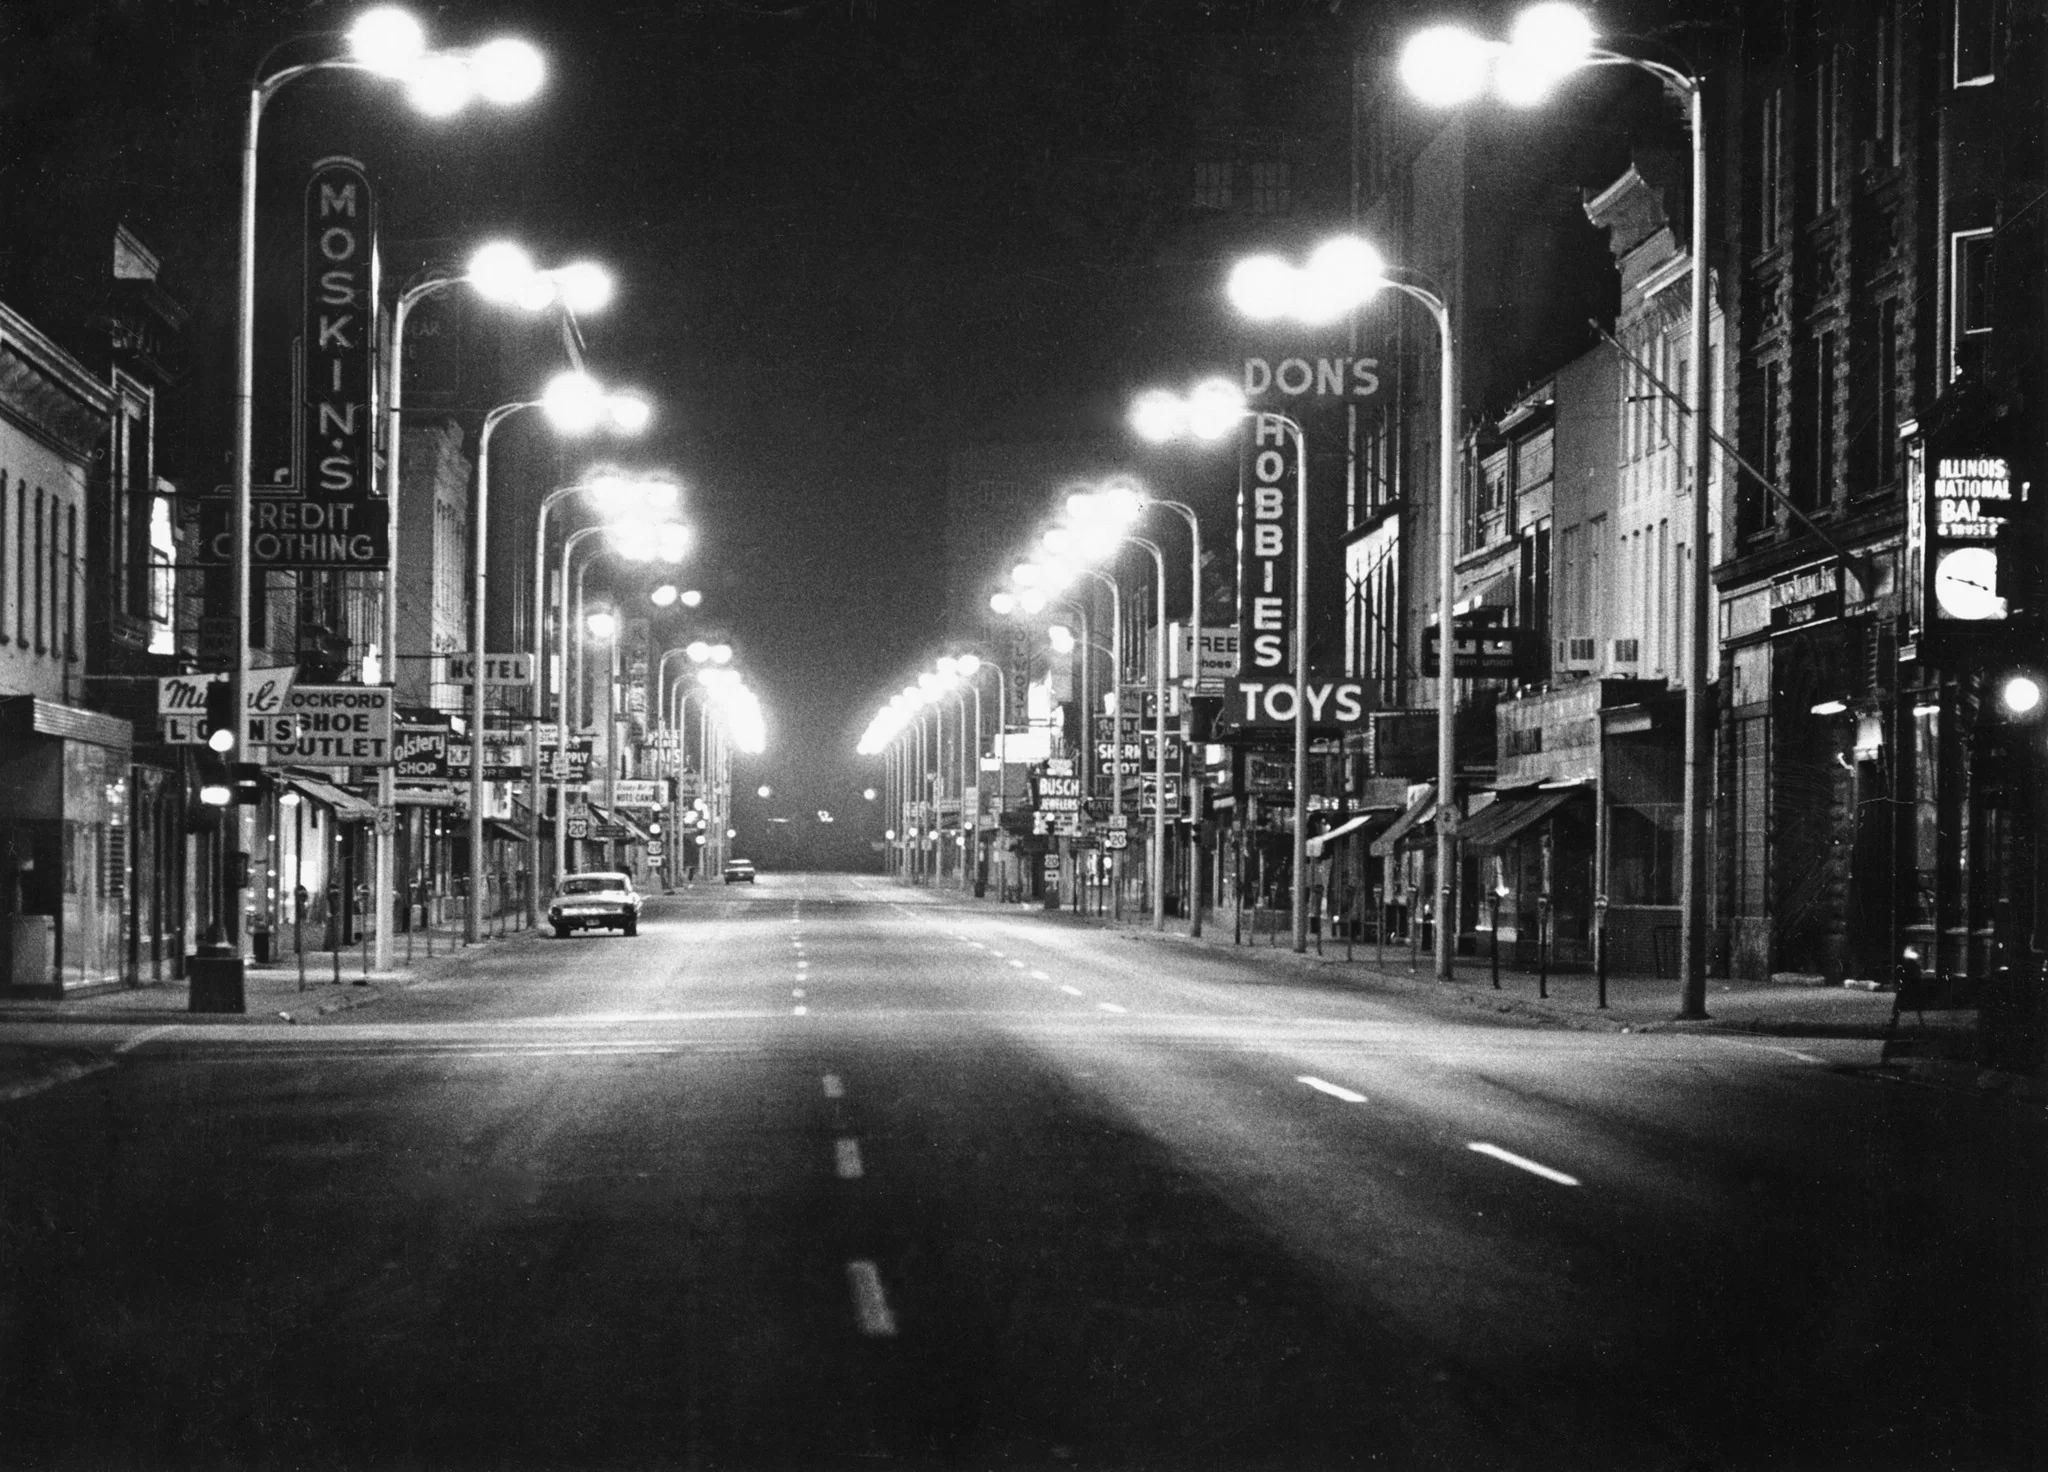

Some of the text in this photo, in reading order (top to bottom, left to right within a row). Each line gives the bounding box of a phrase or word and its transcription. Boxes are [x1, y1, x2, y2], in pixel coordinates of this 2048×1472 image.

[1244, 357, 1380, 396] DON'S
[1939, 458, 2007, 478] ILLINOIS
[1934, 479, 2012, 499] NATIONAL
[1940, 499, 2006, 523] BA
[1937, 523, 1949, 536] &
[1950, 523, 1988, 537] TRUST
[212, 533, 374, 560] COTHING
[1254, 414, 1285, 668] HOBBIES
[451, 660, 525, 679] HOTEL
[1200, 659, 1232, 669] hoes
[1431, 657, 1477, 667] wtern
[165, 680, 279, 711] Mul
[289, 692, 386, 709] OCKFORD
[1239, 683, 1362, 722] TOYS
[170, 719, 292, 741] LONS
[300, 713, 370, 733] SHOE
[398, 762, 437, 775] SHOP
[458, 768, 507, 777] SRE
[1102, 762, 1140, 775] COT
[1039, 777, 1080, 797] BUSCH
[570, 823, 585, 835] 20
[1110, 833, 1125, 846] 20
